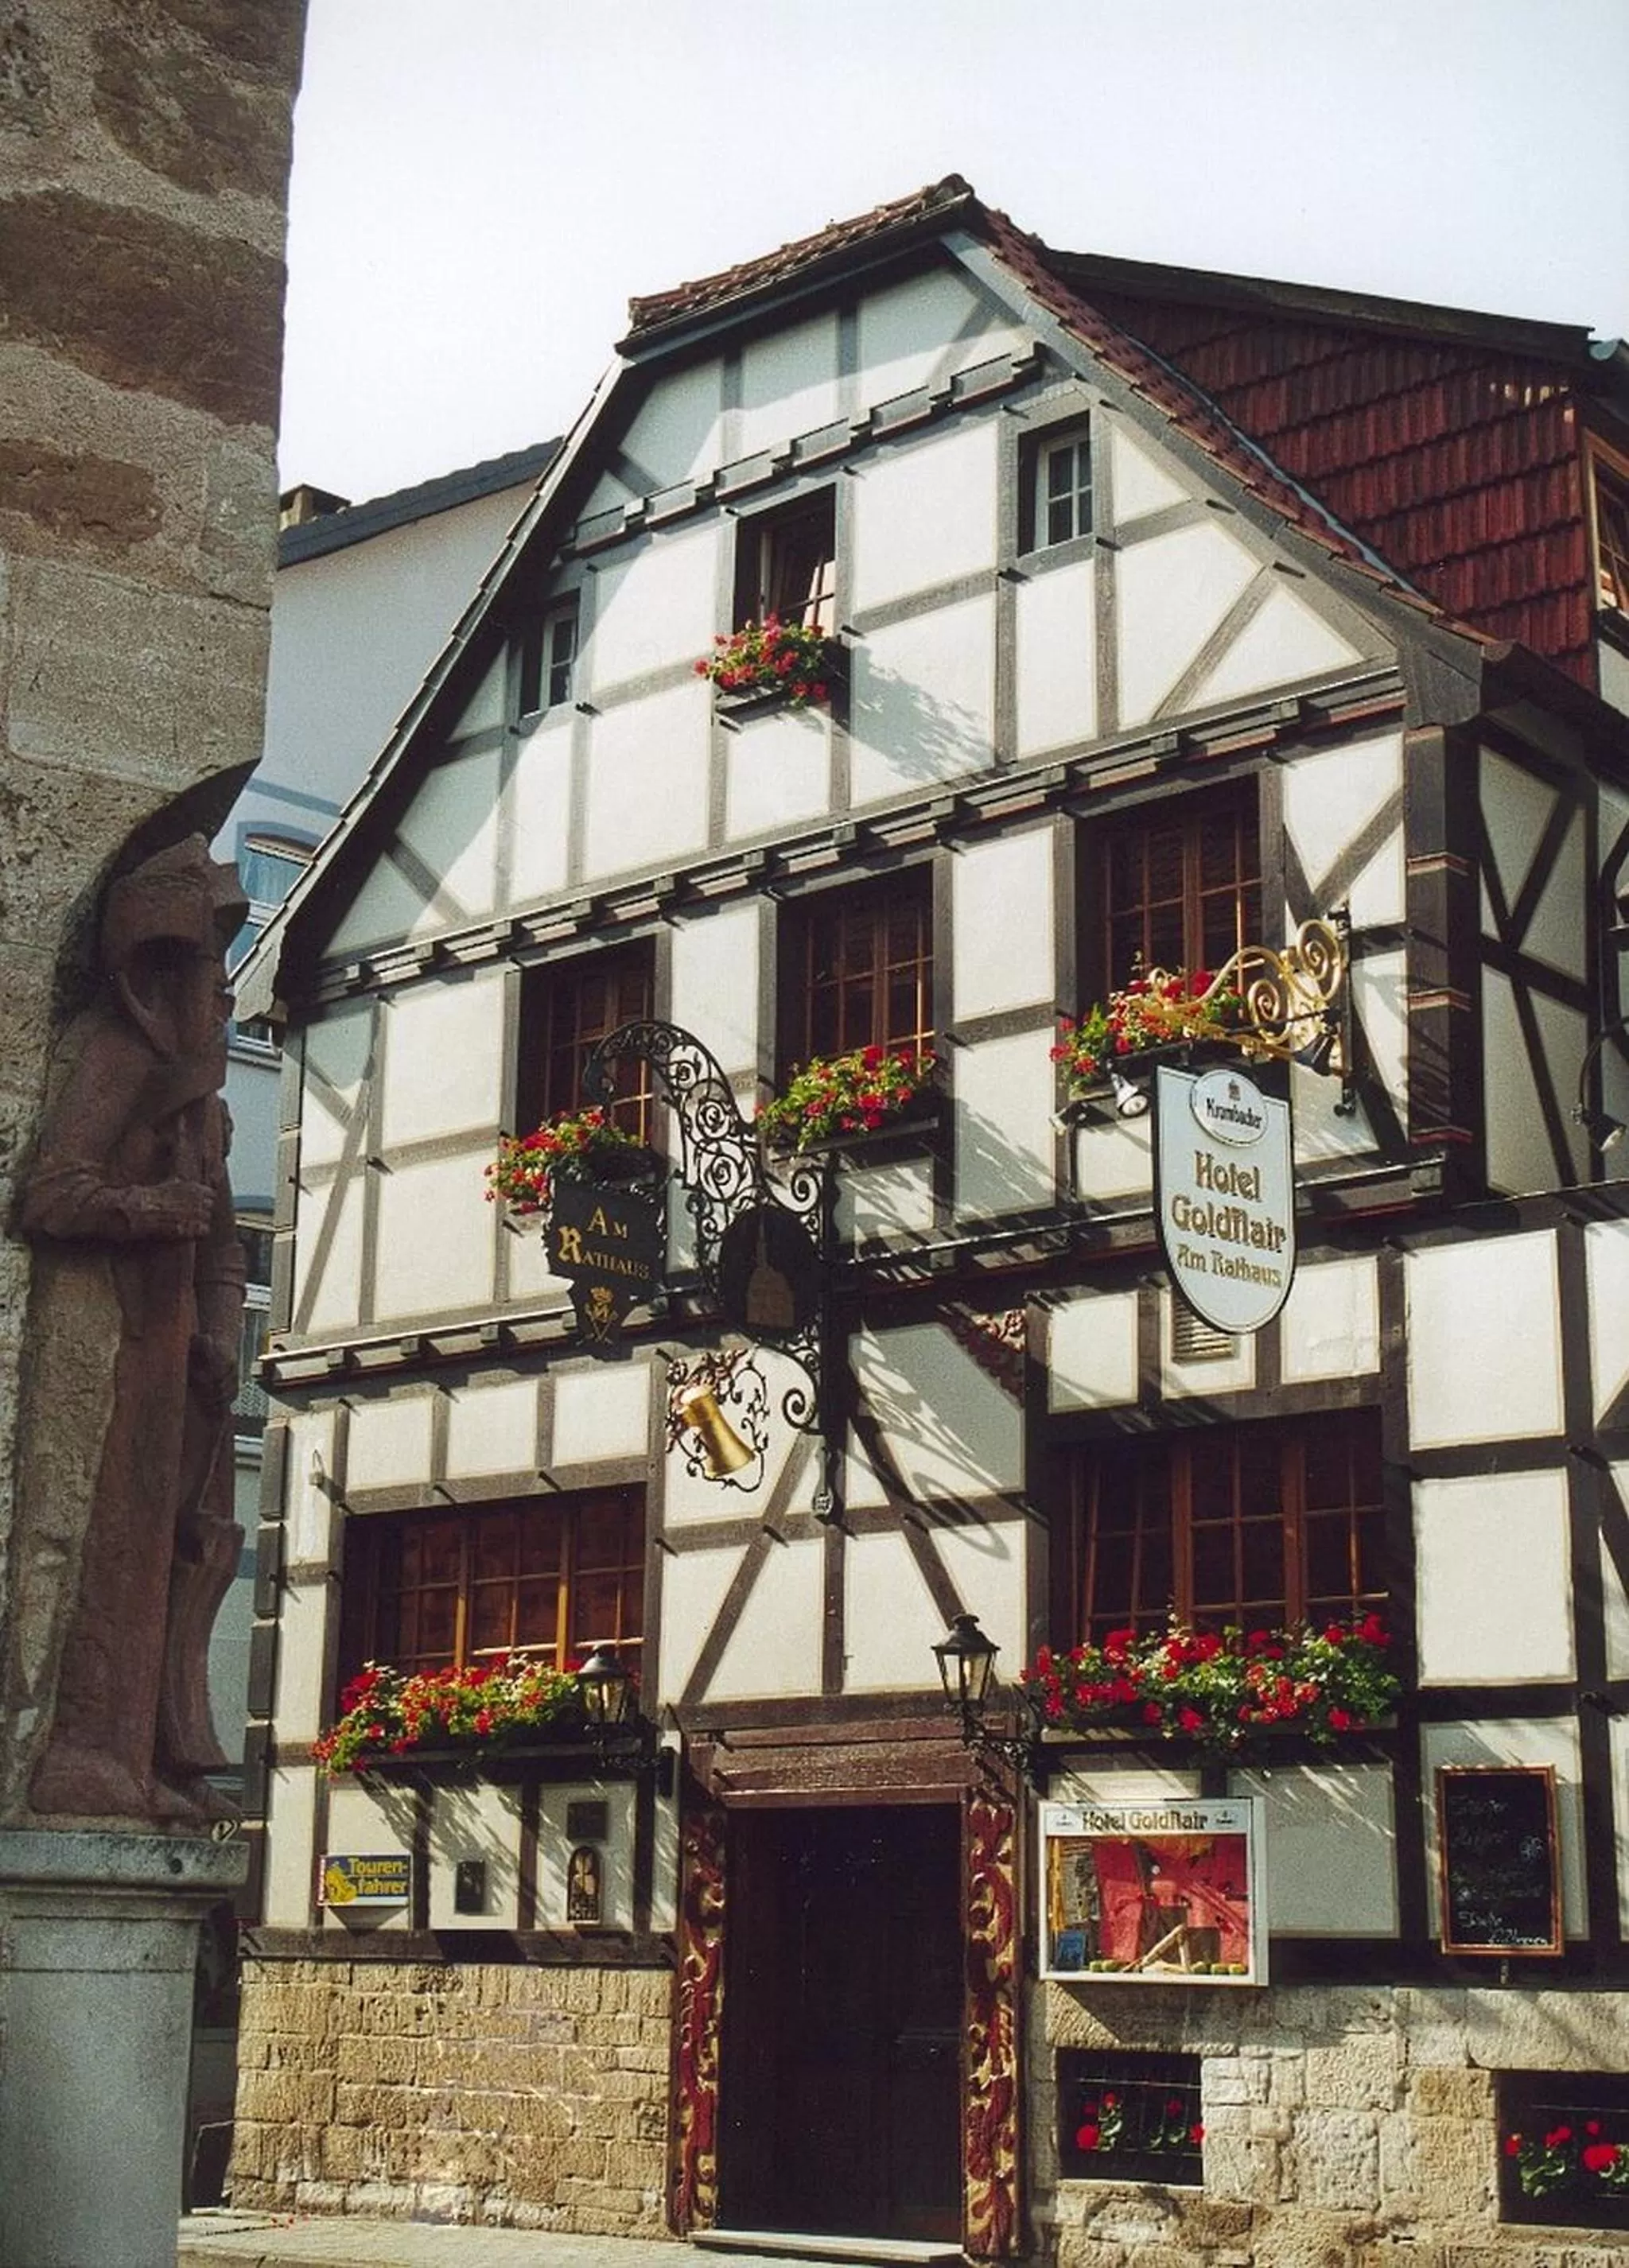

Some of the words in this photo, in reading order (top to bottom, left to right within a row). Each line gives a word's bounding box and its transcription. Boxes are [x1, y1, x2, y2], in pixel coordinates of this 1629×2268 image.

[1194, 1150, 1262, 1202] Hotel
[1211, 1249, 1282, 1288] Rathaus
[1083, 1811, 1126, 1831] Hotel
